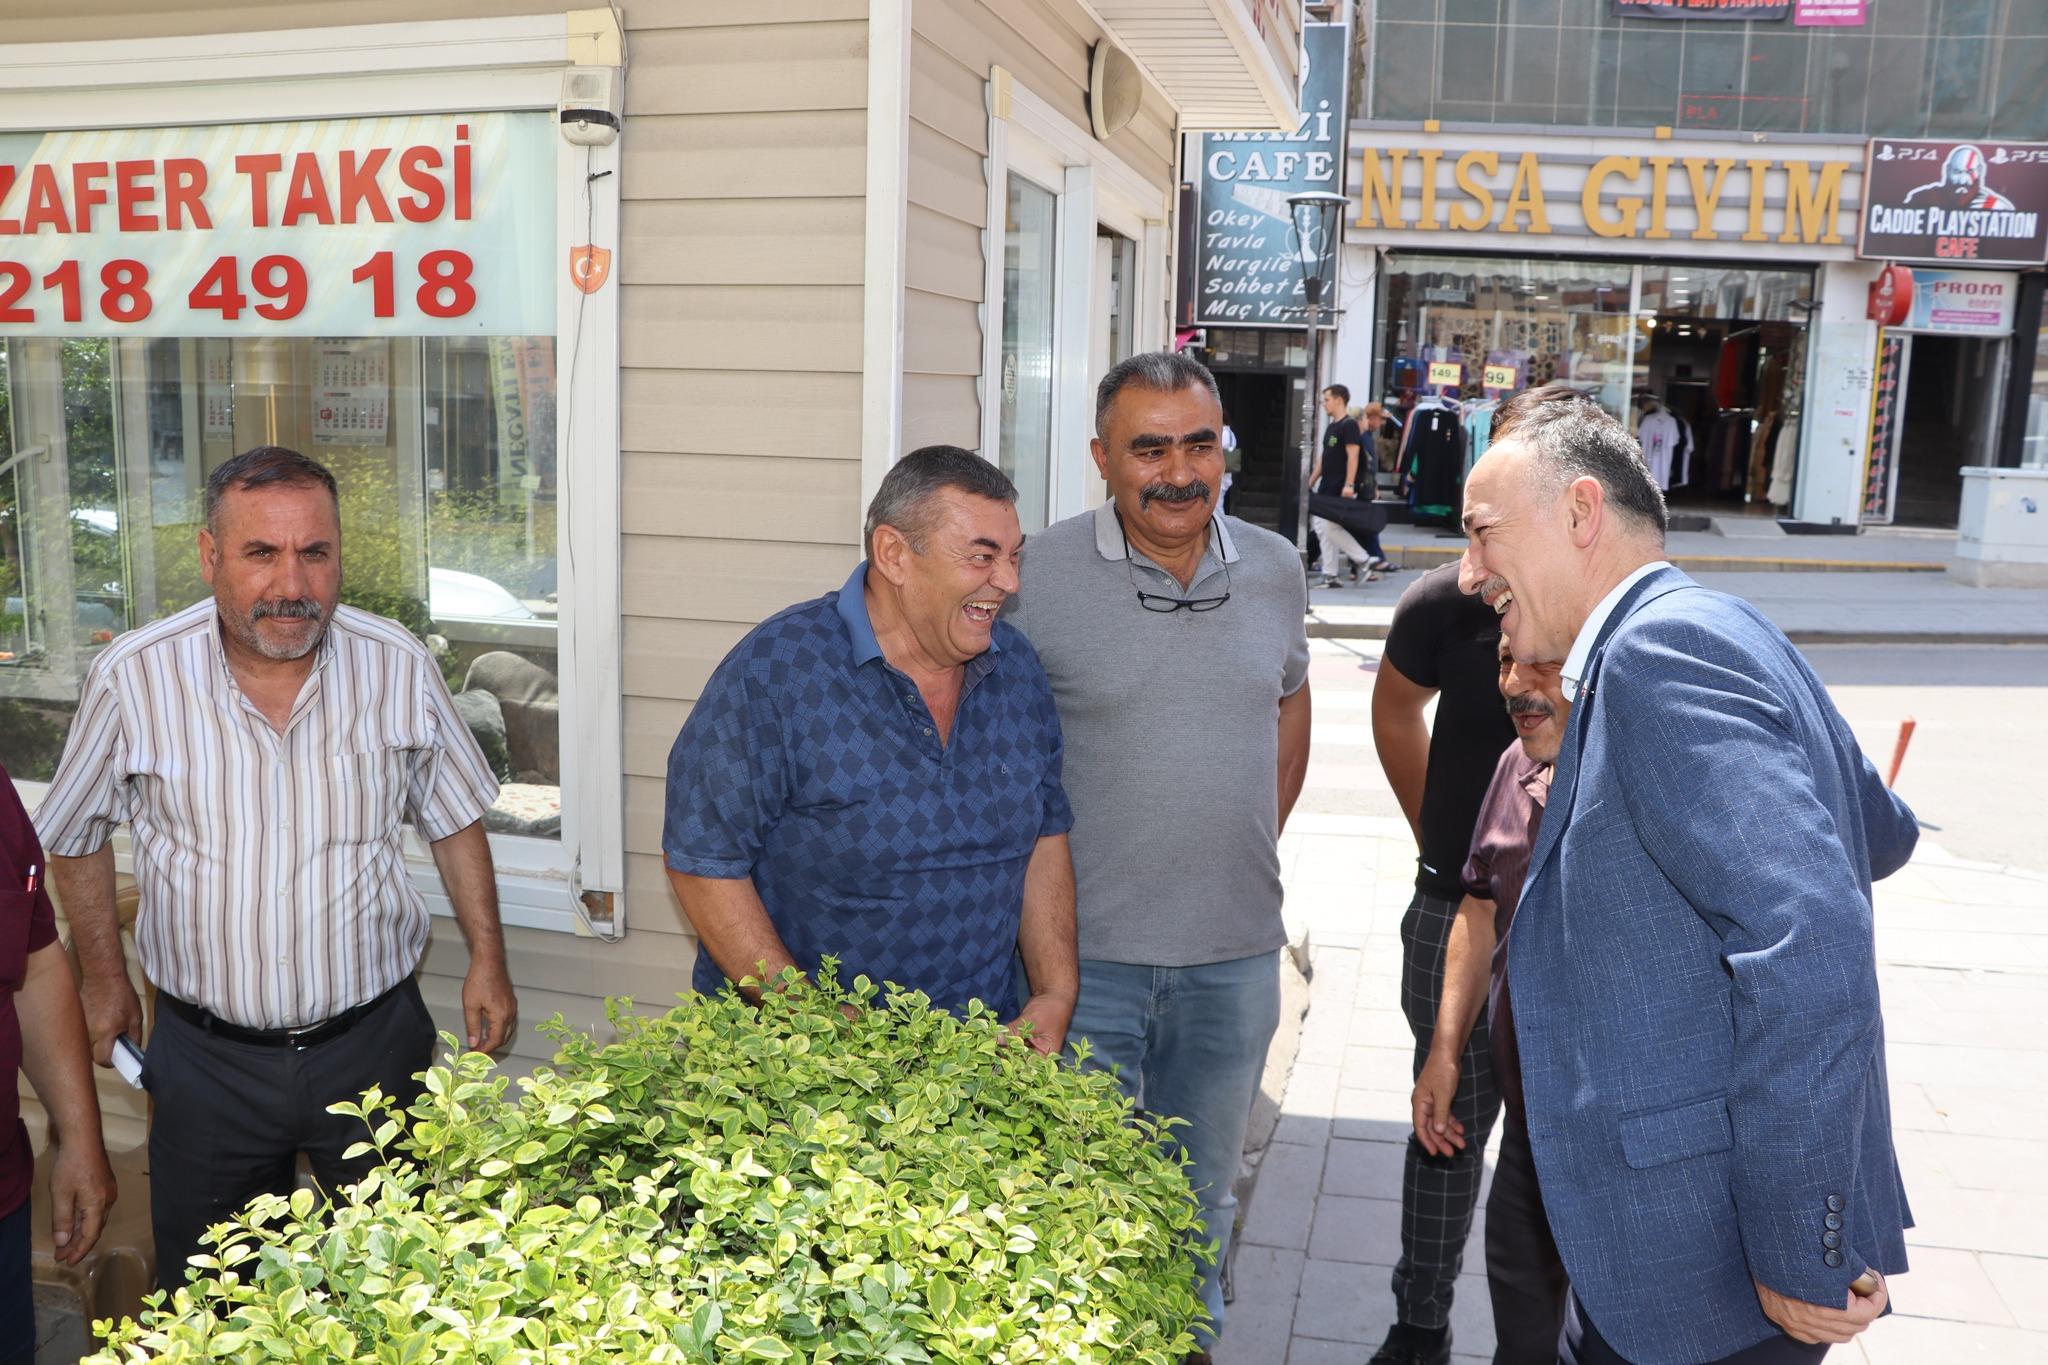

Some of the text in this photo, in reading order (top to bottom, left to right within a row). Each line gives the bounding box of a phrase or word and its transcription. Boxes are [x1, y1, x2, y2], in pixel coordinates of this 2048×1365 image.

[1211, 99, 1332, 141] Zİ
[1208, 150, 1335, 181] CAFE
[1898, 148, 1938, 160] PS4
[235, 124, 472, 228] TAKSİ
[1356, 148, 1849, 245] NISA GIYIM
[1206, 208, 1266, 231] Okey
[1870, 203, 2038, 239] CADDE PLAYSTATION
[1206, 232, 1267, 249] Tavla
[1935, 236, 1980, 258] CAFE
[1205, 254, 1292, 276] Nargile
[188, 254, 308, 321] 49
[352, 249, 477, 319] 18
[1204, 276, 1333, 296] Sohbet Ei
[1203, 299, 1253, 321] Maç
